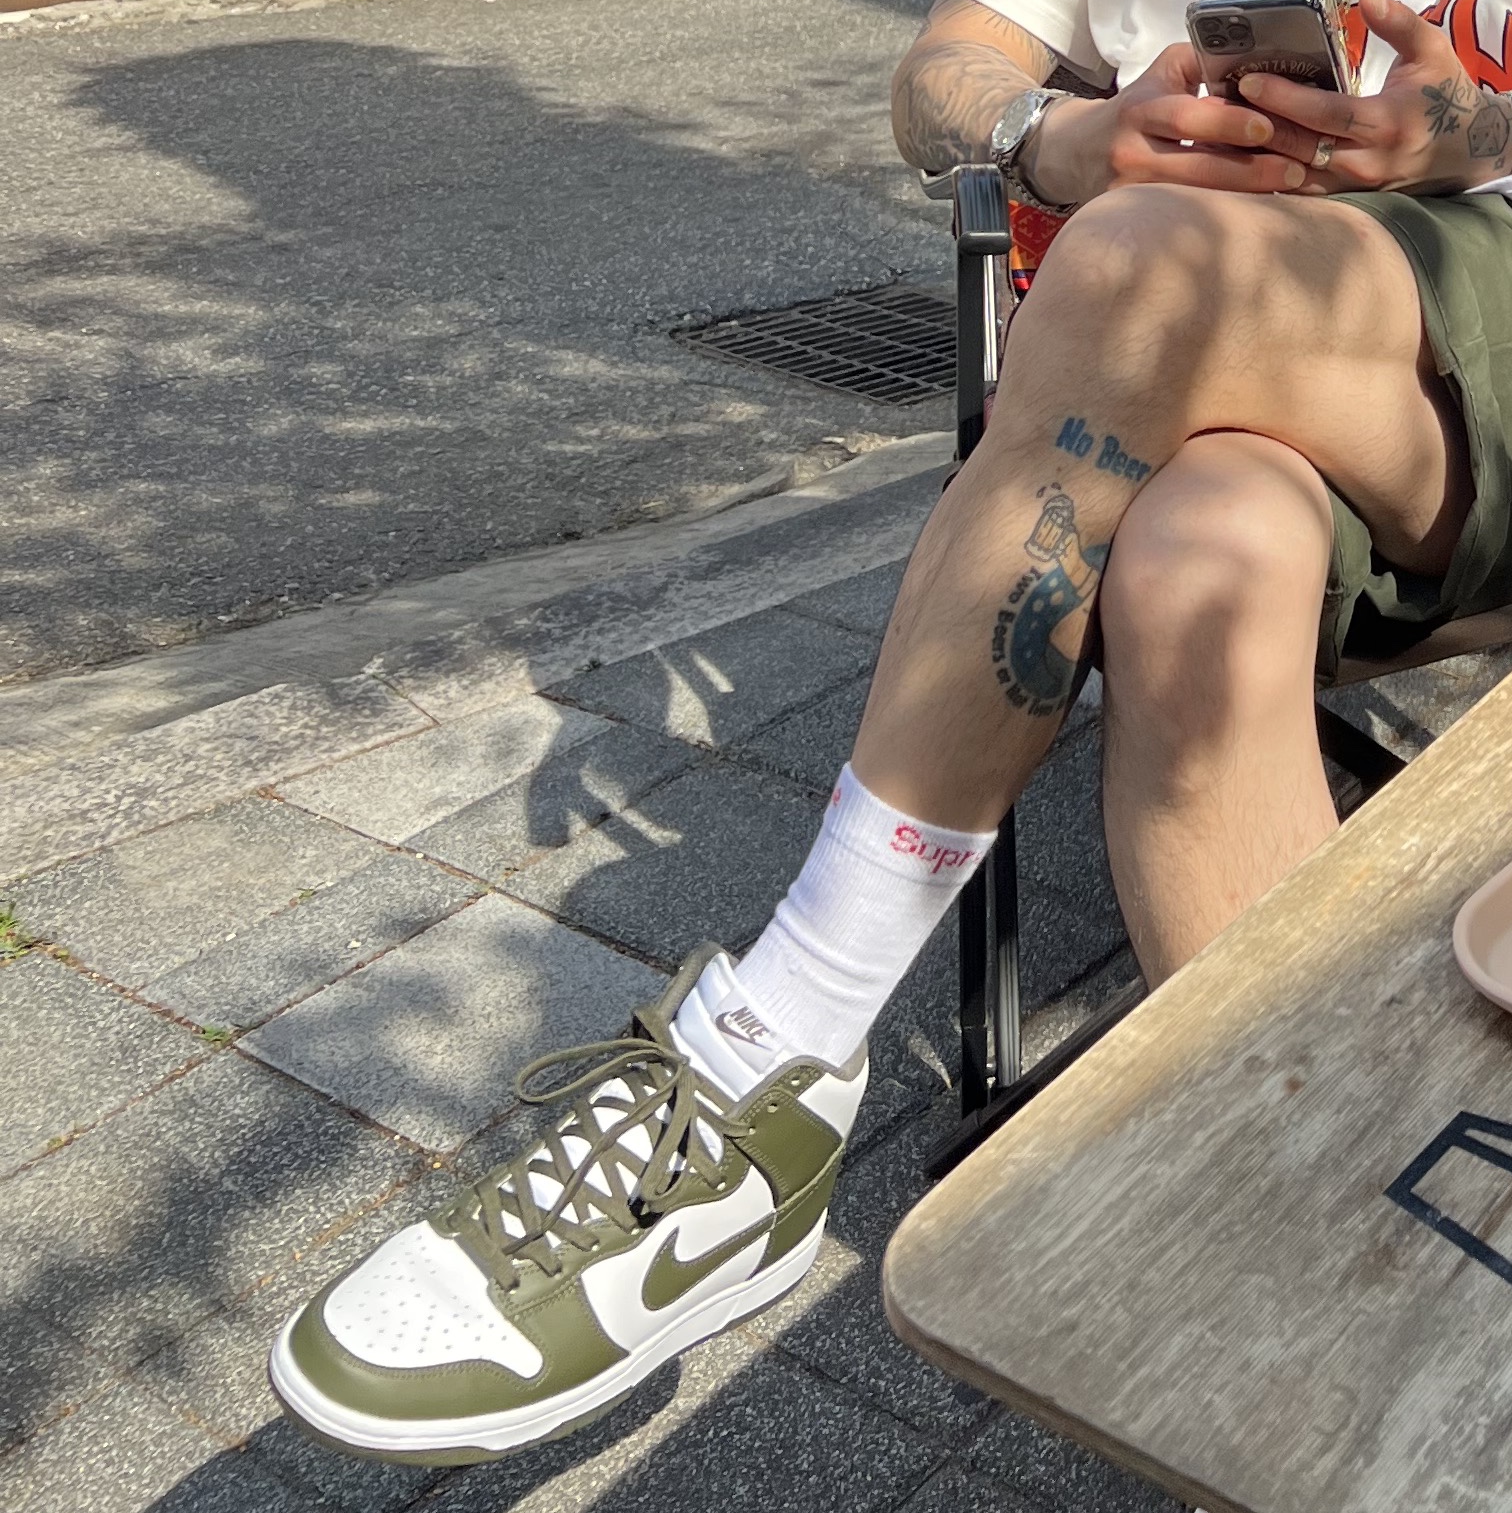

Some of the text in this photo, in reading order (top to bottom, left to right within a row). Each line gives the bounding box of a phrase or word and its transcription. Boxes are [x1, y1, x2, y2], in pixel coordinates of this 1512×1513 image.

[1055, 417, 1153, 483] No Beer
[729, 1004, 771, 1044] NIKE
